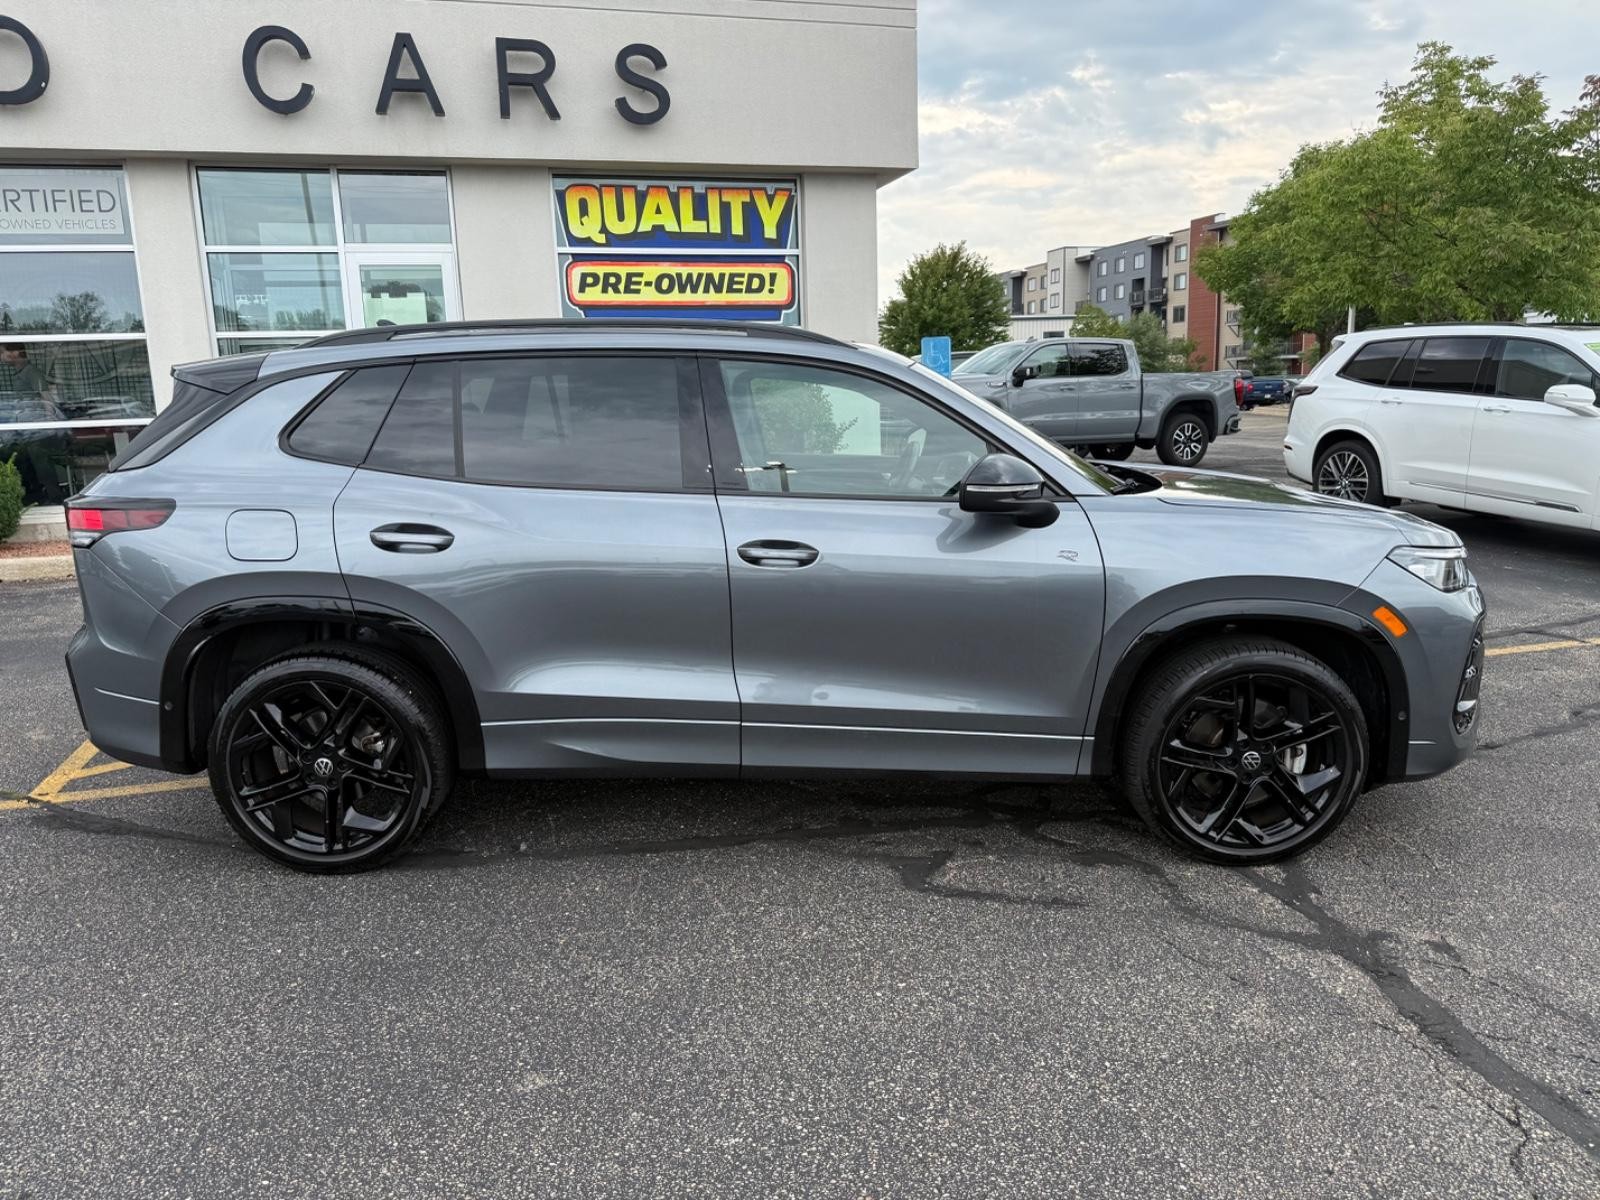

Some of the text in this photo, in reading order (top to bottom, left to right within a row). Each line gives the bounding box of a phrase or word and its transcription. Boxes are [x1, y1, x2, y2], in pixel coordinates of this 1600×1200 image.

[242, 25, 671, 126] CARS
[0, 188, 117, 213] RTIFIED
[55, 218, 117, 230] VEHICLES
[565, 184, 790, 243] QUALITY
[578, 271, 777, 295] PRE-OWNED!
